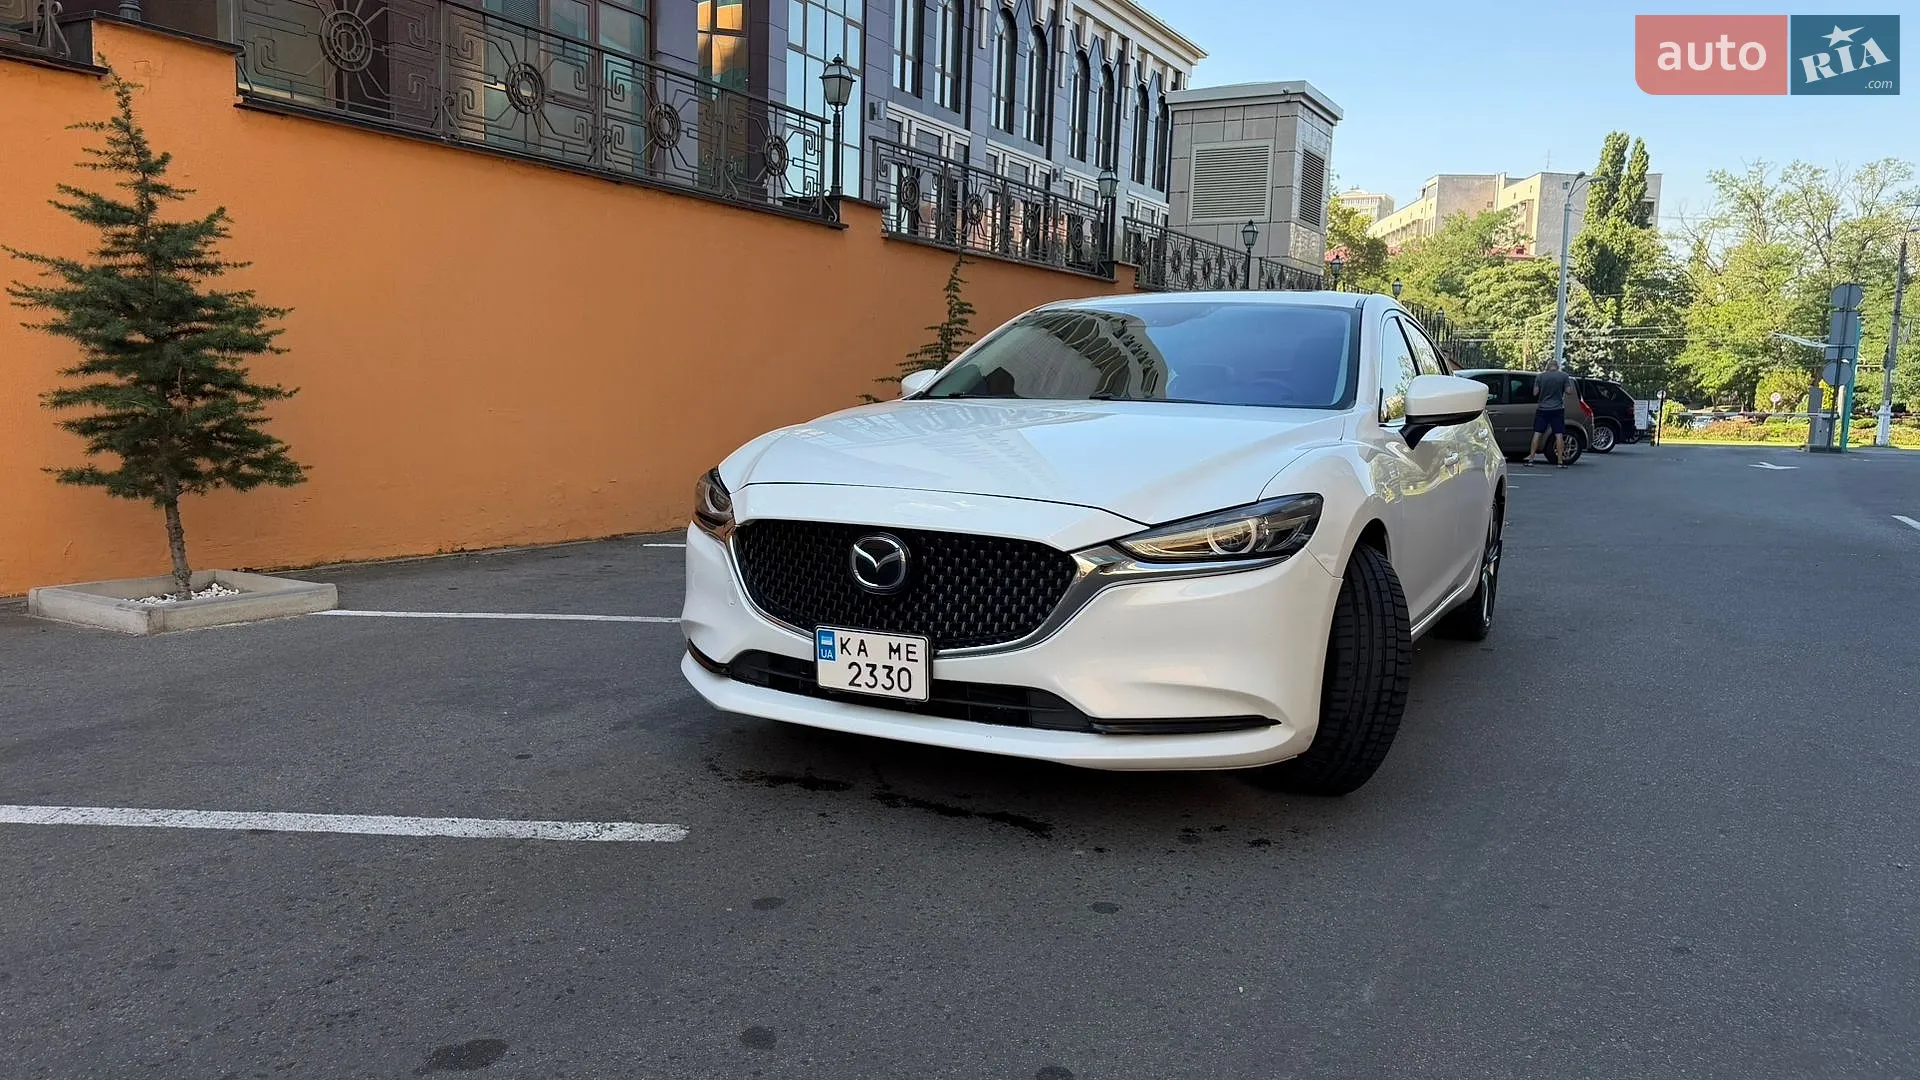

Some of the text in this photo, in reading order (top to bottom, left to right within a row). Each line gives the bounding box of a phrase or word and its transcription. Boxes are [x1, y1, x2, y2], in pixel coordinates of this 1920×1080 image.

[820, 648, 834, 659] UA
[840, 636, 918, 662] KA ME
[848, 661, 912, 692] 2330
